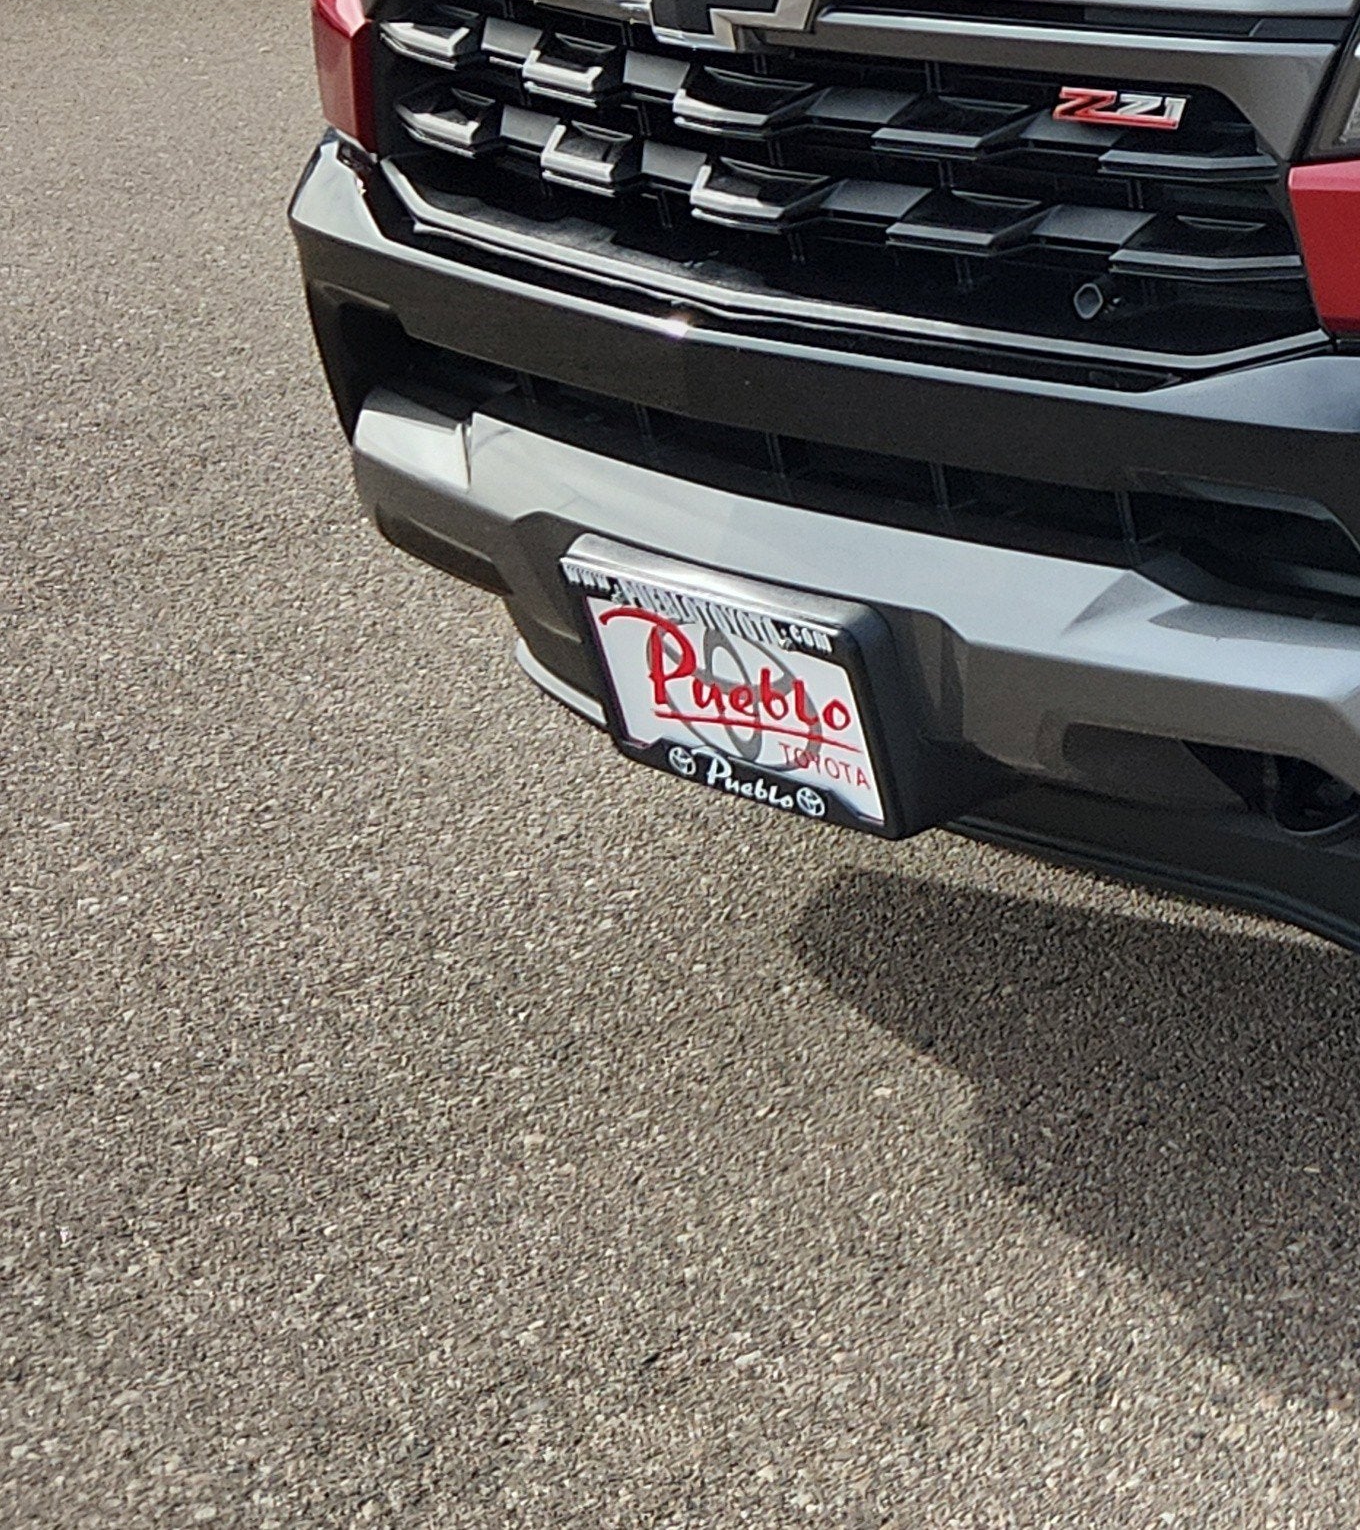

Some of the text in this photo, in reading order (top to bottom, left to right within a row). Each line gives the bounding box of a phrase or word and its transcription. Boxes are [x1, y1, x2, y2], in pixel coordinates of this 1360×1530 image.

[1052, 86, 1187, 130] Z71
[599, 606, 852, 731] Pueblo
[691, 744, 795, 809] Pueblo
[778, 741, 872, 790] TOYOTA
